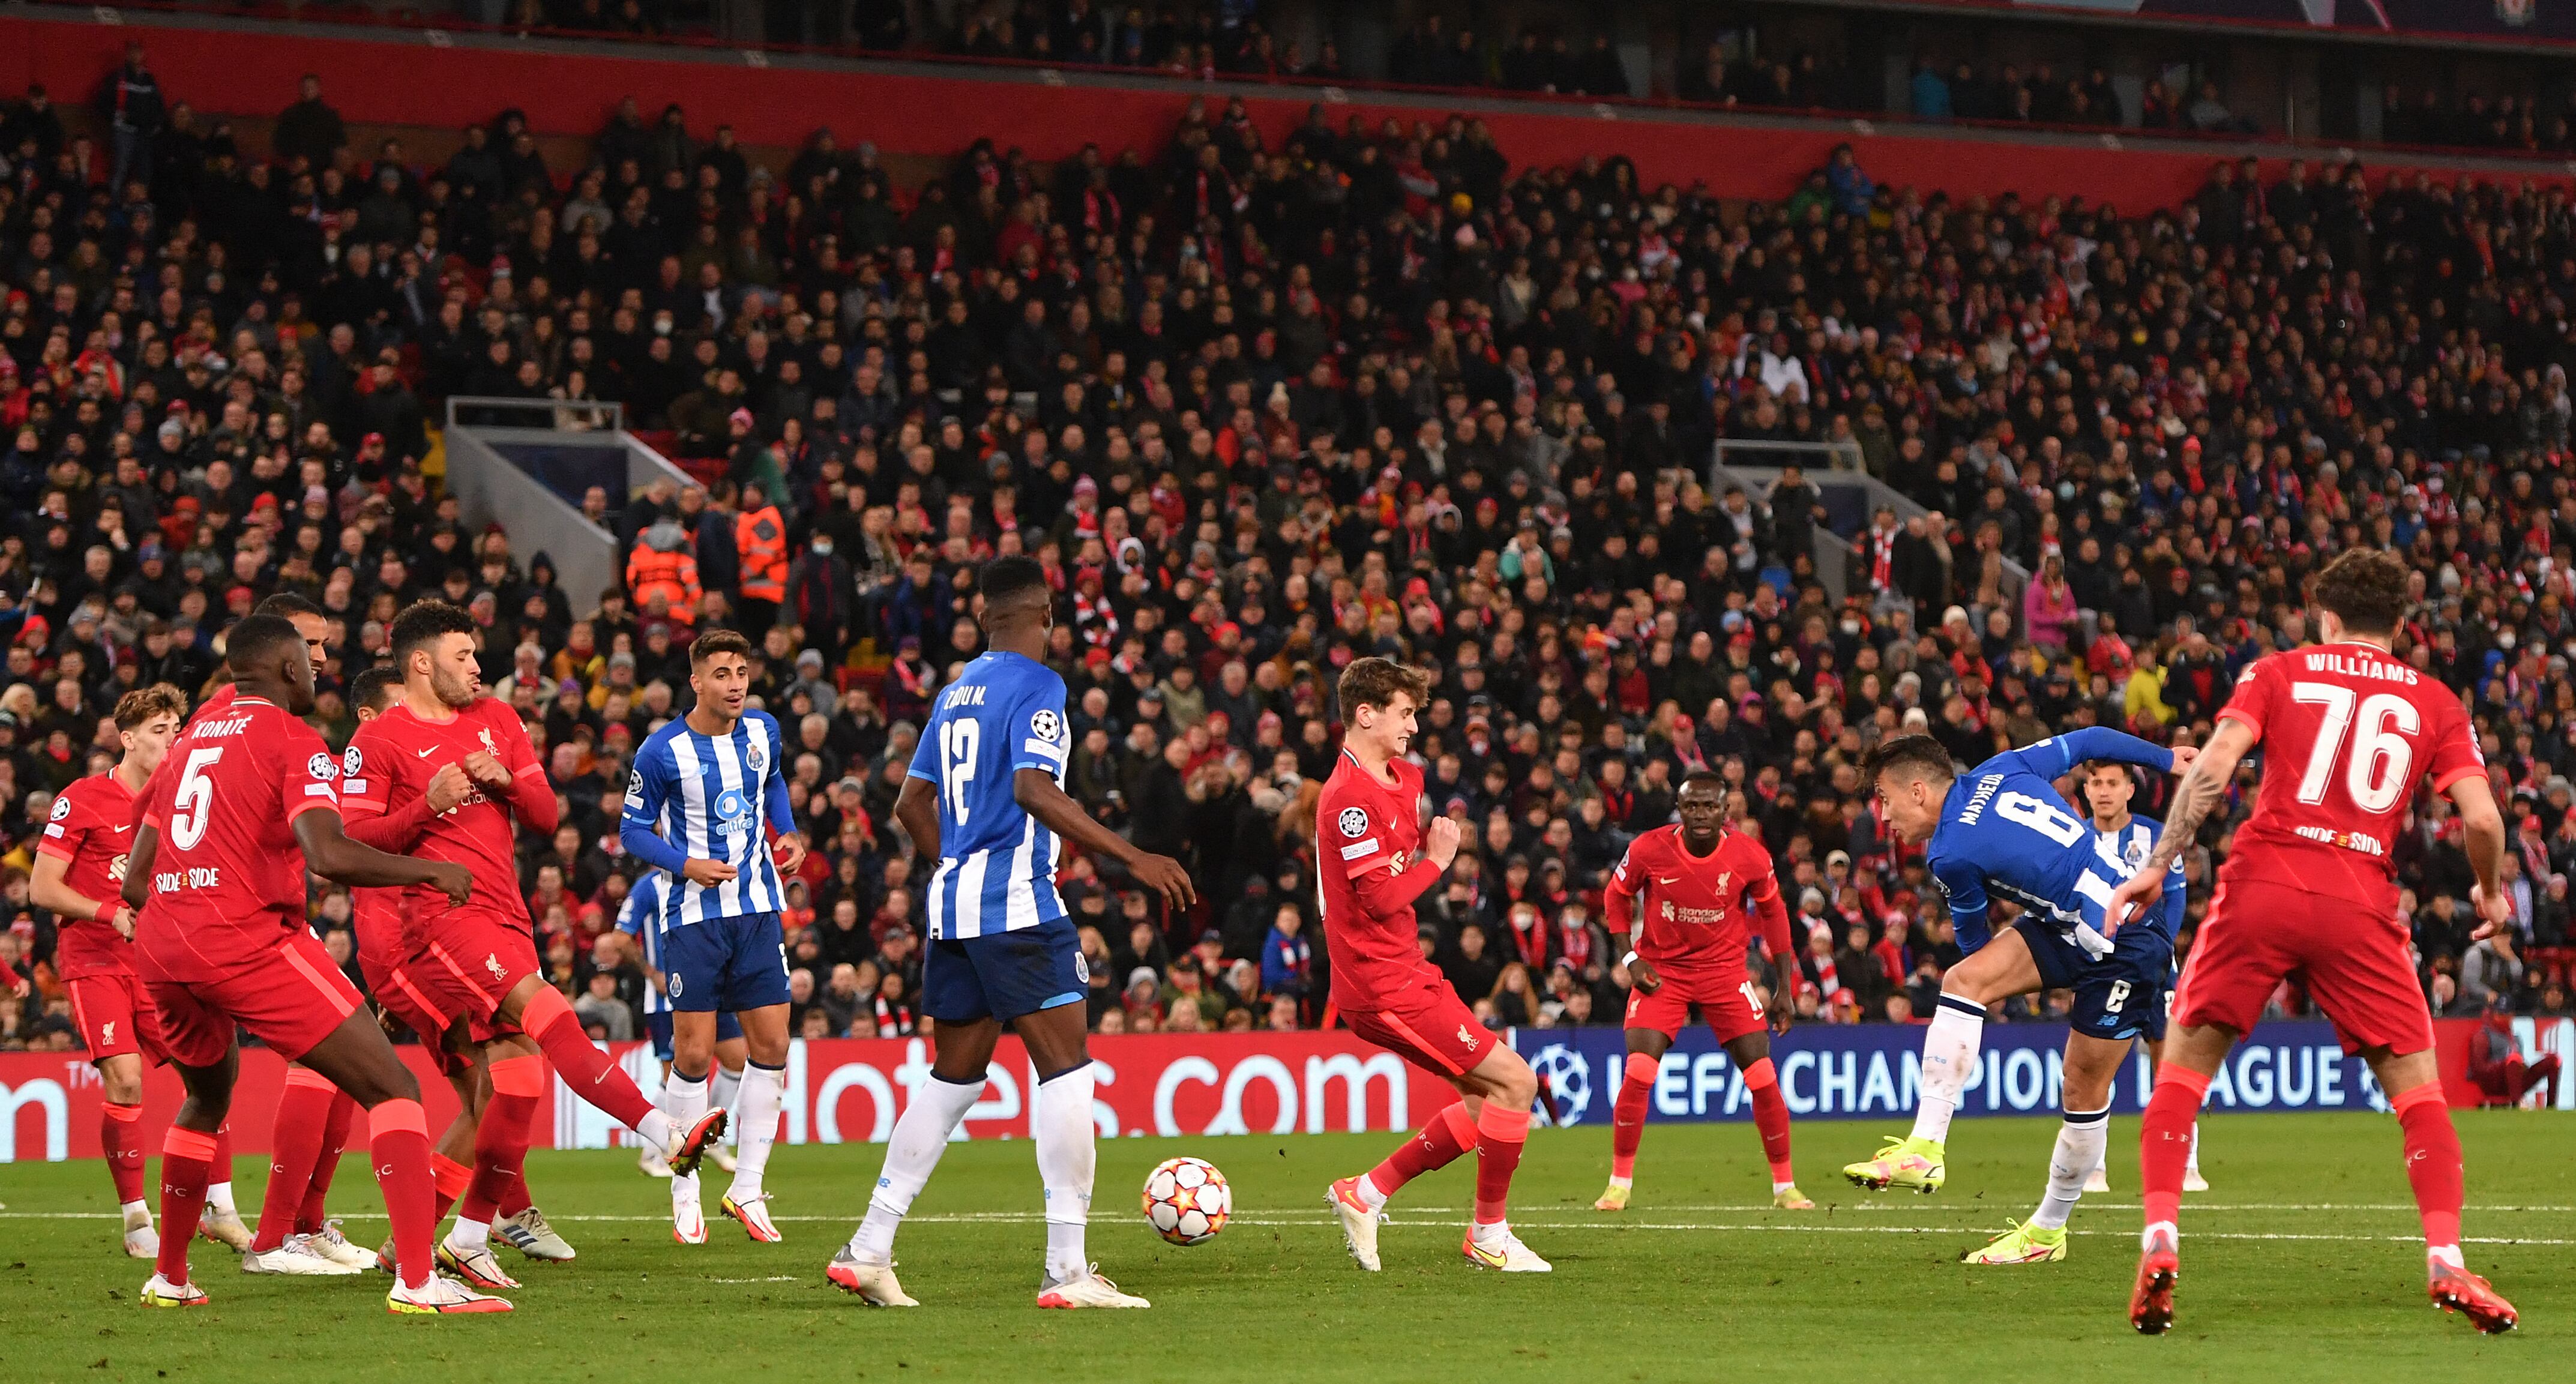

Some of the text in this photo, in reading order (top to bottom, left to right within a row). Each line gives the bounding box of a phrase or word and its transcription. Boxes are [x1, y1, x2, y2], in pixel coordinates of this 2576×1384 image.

[2306, 654, 2419, 685] WILLIAMS
[191, 715, 254, 739] KONATÉ
[2292, 681, 2421, 814] 76
[939, 718, 980, 826] 12
[171, 746, 224, 851] 5
[716, 817, 754, 835] altice
[1995, 791, 2086, 849] 8
[155, 871, 182, 894] SIDE
[188, 867, 220, 889] SIDE
[1779, 1047, 2116, 1115] CHAPION
[2136, 1045, 2346, 1107] LAGUE
[1418, 1128, 1434, 1152] FC
[2162, 1131, 2192, 1146] LF
[160, 1179, 187, 1197] FC
